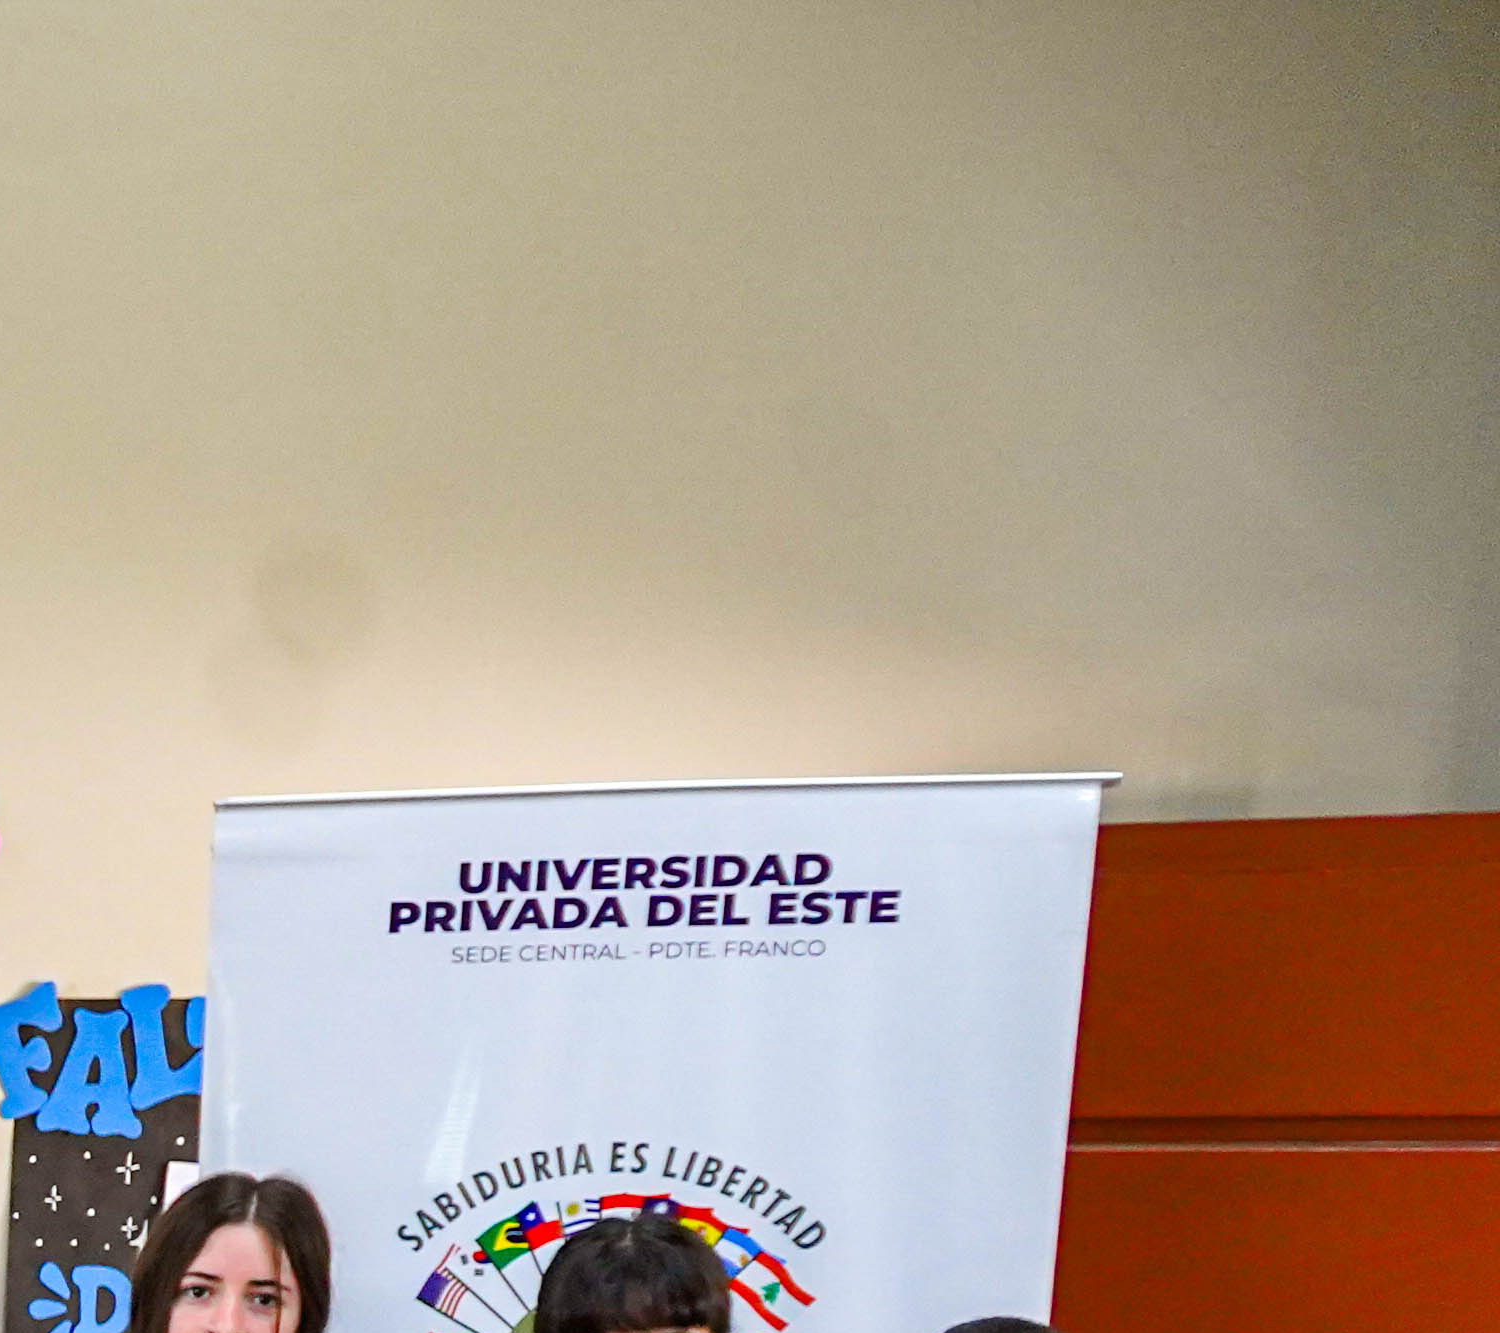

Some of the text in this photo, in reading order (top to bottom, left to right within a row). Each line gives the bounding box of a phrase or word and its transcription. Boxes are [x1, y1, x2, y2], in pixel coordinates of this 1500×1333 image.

[459, 853, 833, 894] UNIVERSIDAD
[388, 889, 901, 933] PRIVADA DEL ESTE
[451, 946, 512, 964] SEDE
[519, 943, 627, 961] CENTRAL
[648, 941, 717, 960] PDTE.
[724, 940, 827, 957] FRANCO
[396, 1141, 827, 1254] SABIDURIA ES LIBERTAD
